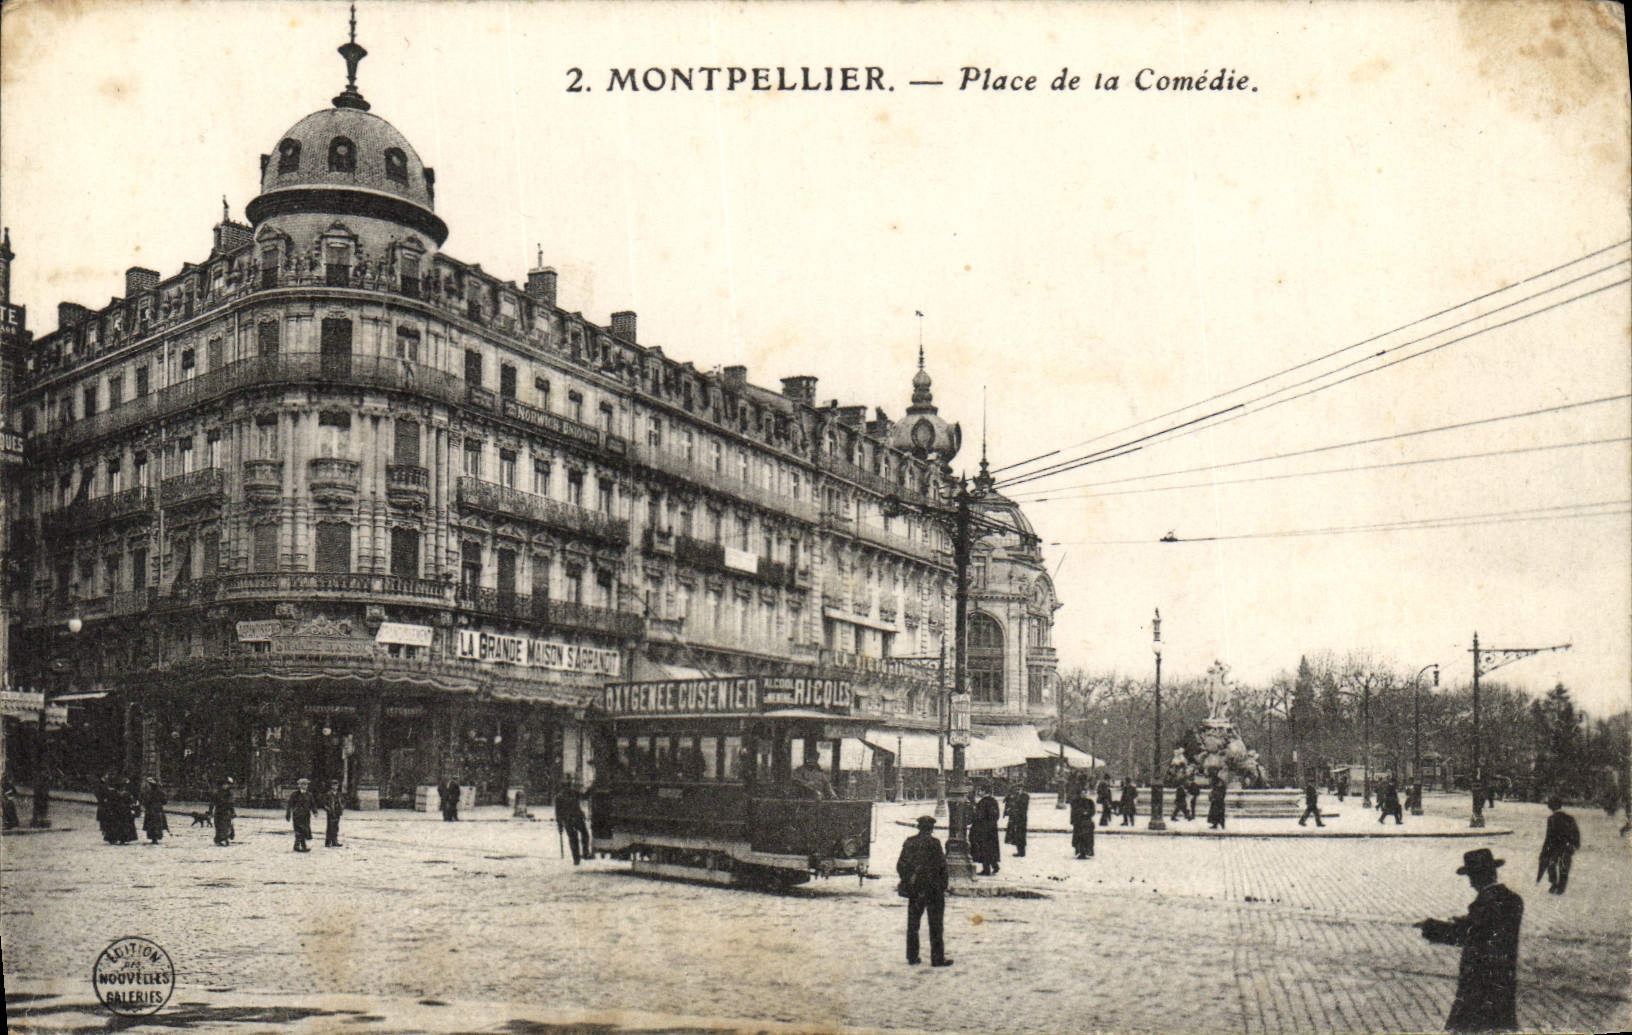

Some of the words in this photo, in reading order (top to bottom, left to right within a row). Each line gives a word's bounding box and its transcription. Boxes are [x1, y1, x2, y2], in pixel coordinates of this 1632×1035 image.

[460, 632, 474, 656] LA
[479, 632, 523, 662] GRANDE
[527, 639, 563, 667] MAISON
[678, 679, 756, 709] CUSENIER
